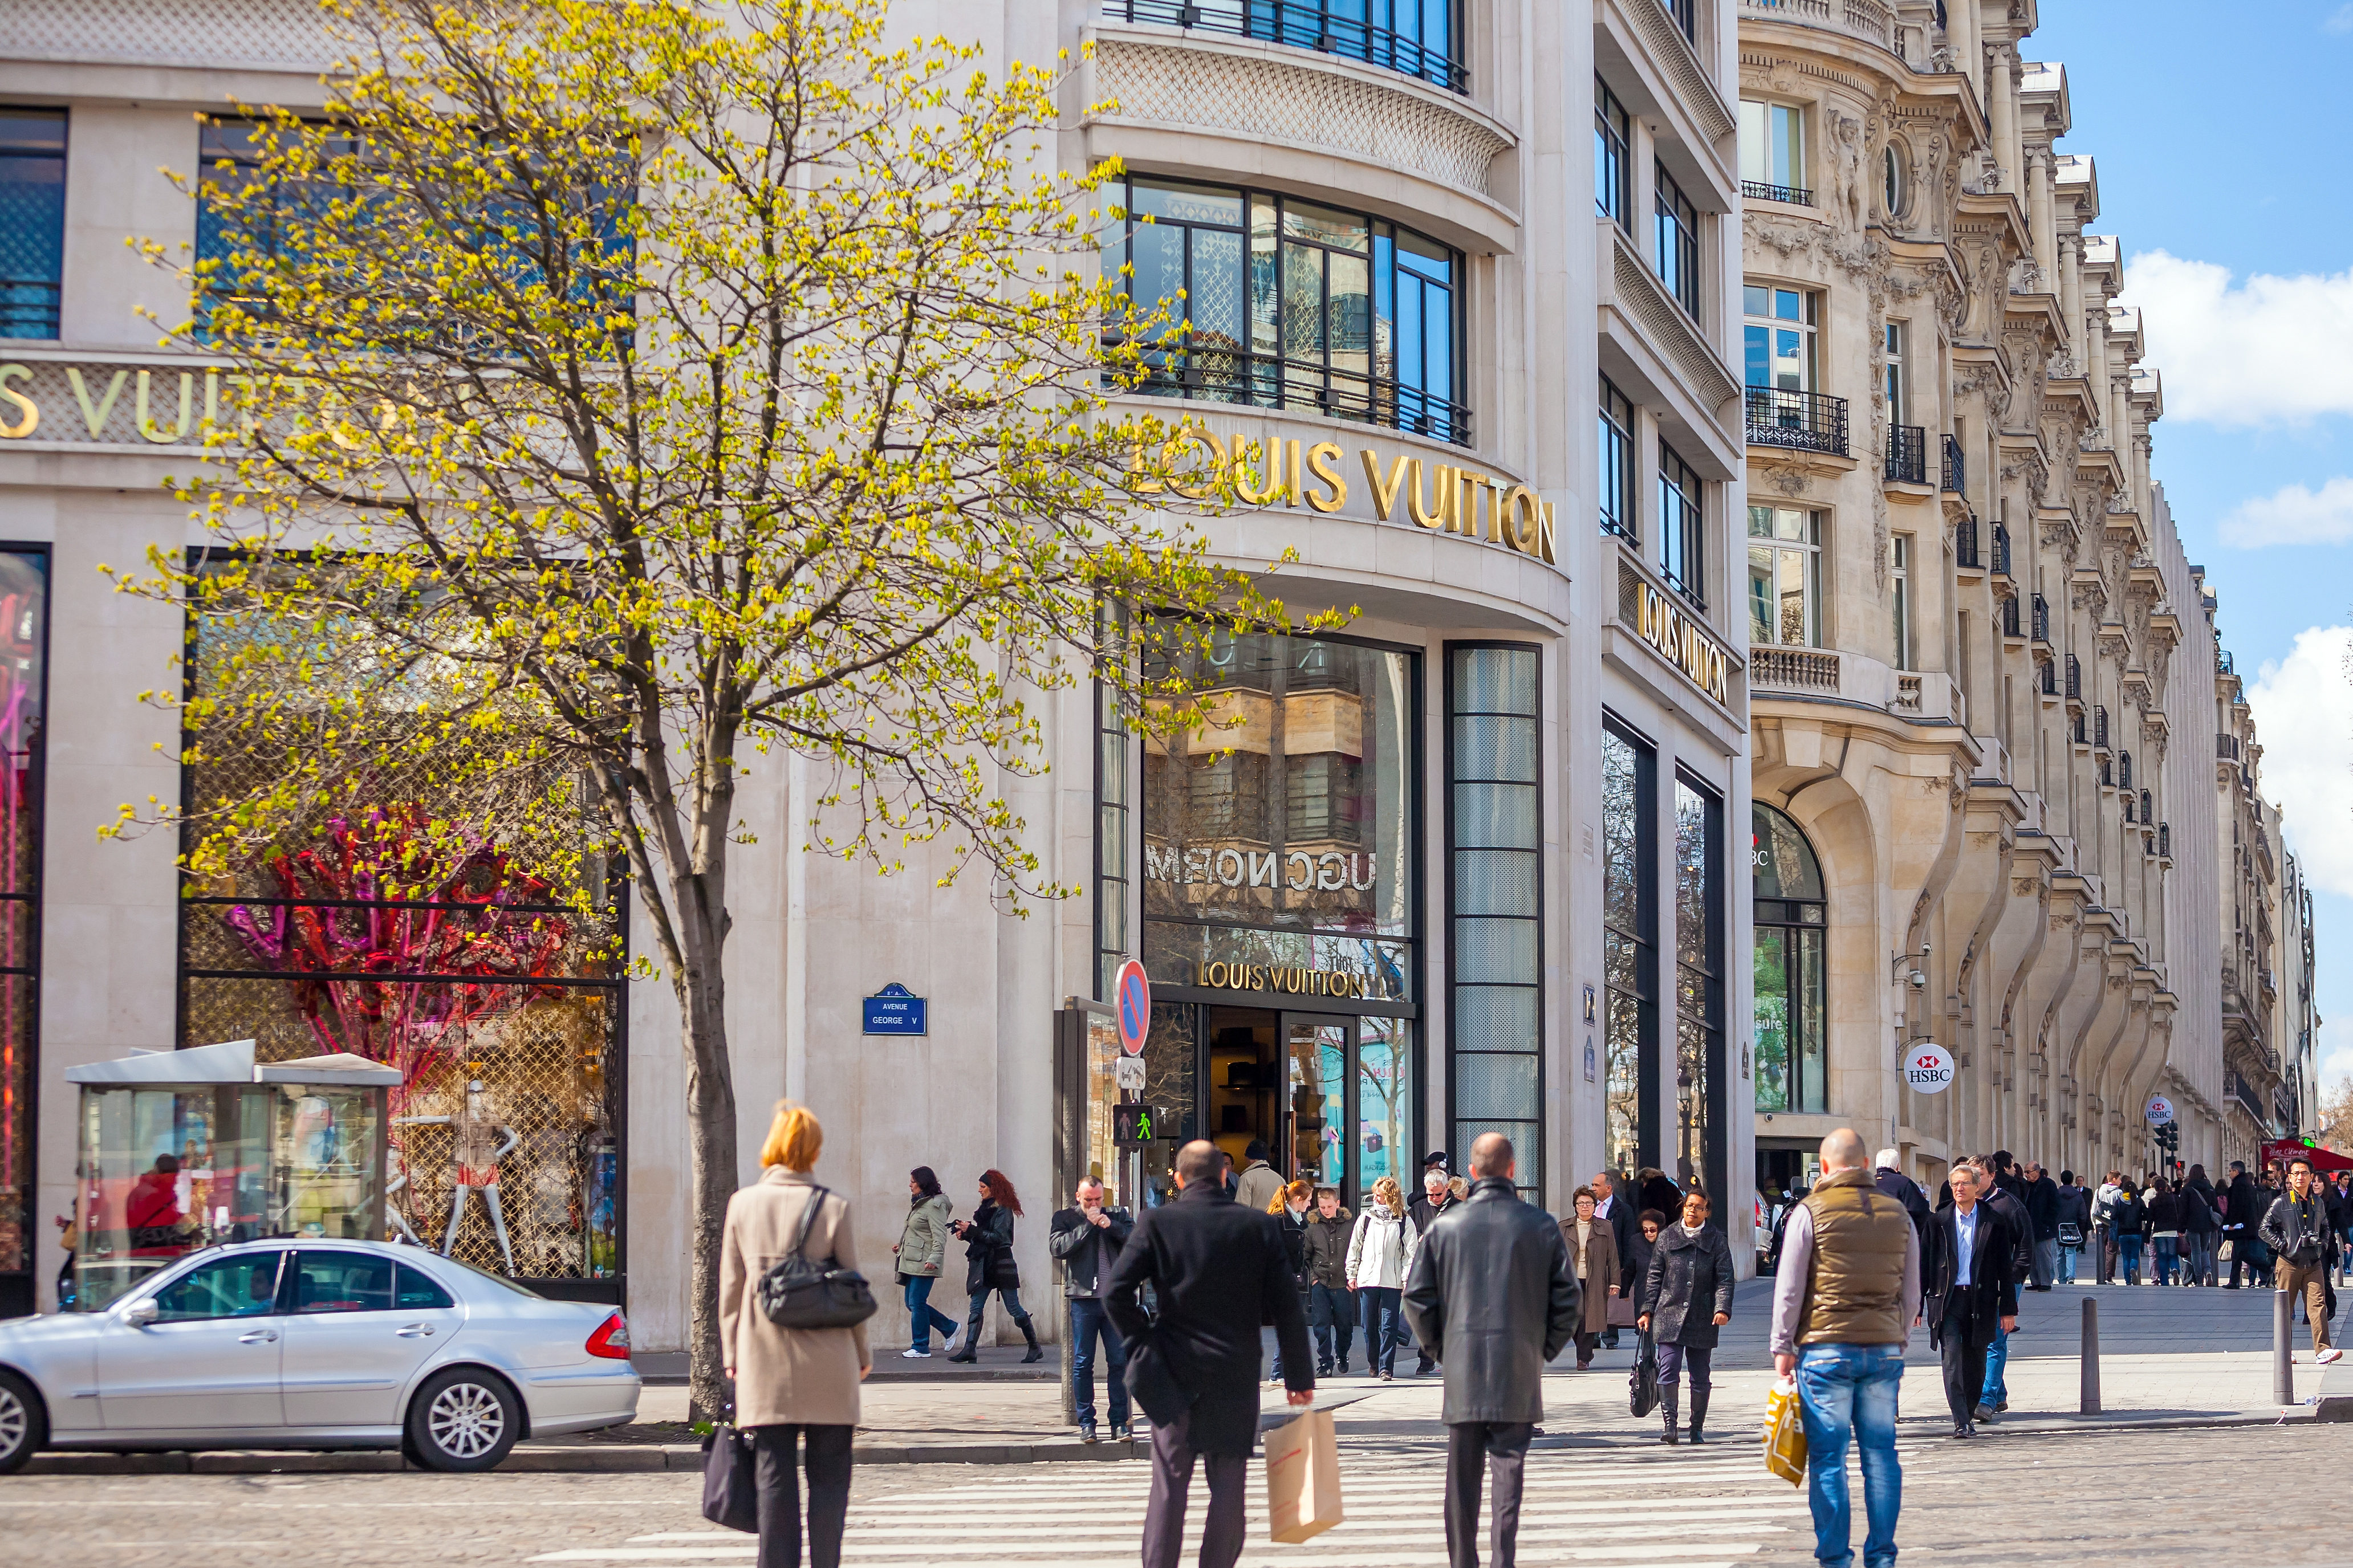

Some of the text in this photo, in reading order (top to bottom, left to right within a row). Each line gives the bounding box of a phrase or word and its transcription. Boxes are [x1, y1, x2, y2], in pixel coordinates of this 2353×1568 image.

[1129, 425, 1556, 565] LOUIS VUITTON
[1637, 583, 1727, 706] LOUIS VUITTON
[1198, 962, 1365, 999] LOUIS VUITTON
[1909, 1069, 1950, 1083] HSBC
